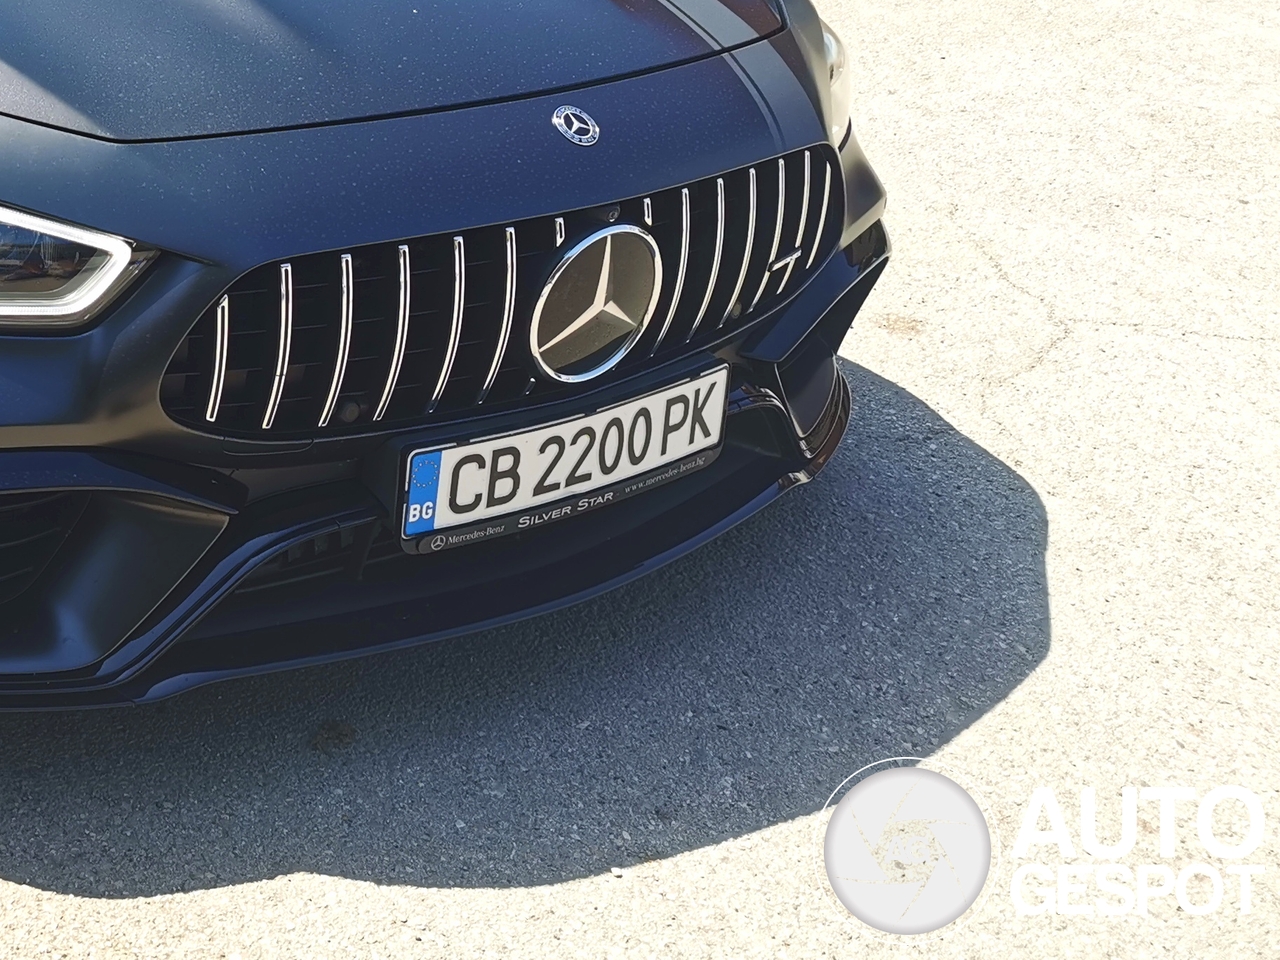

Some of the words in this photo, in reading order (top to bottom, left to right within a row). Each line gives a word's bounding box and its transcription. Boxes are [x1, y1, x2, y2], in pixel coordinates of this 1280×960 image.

[449, 446, 521, 515] CB
[532, 407, 652, 497] 2200
[660, 381, 718, 457] PK
[409, 501, 434, 522] BG
[447, 525, 505, 544] Mercedes-Benz
[624, 456, 705, 493] www.mercedes-benz.bg
